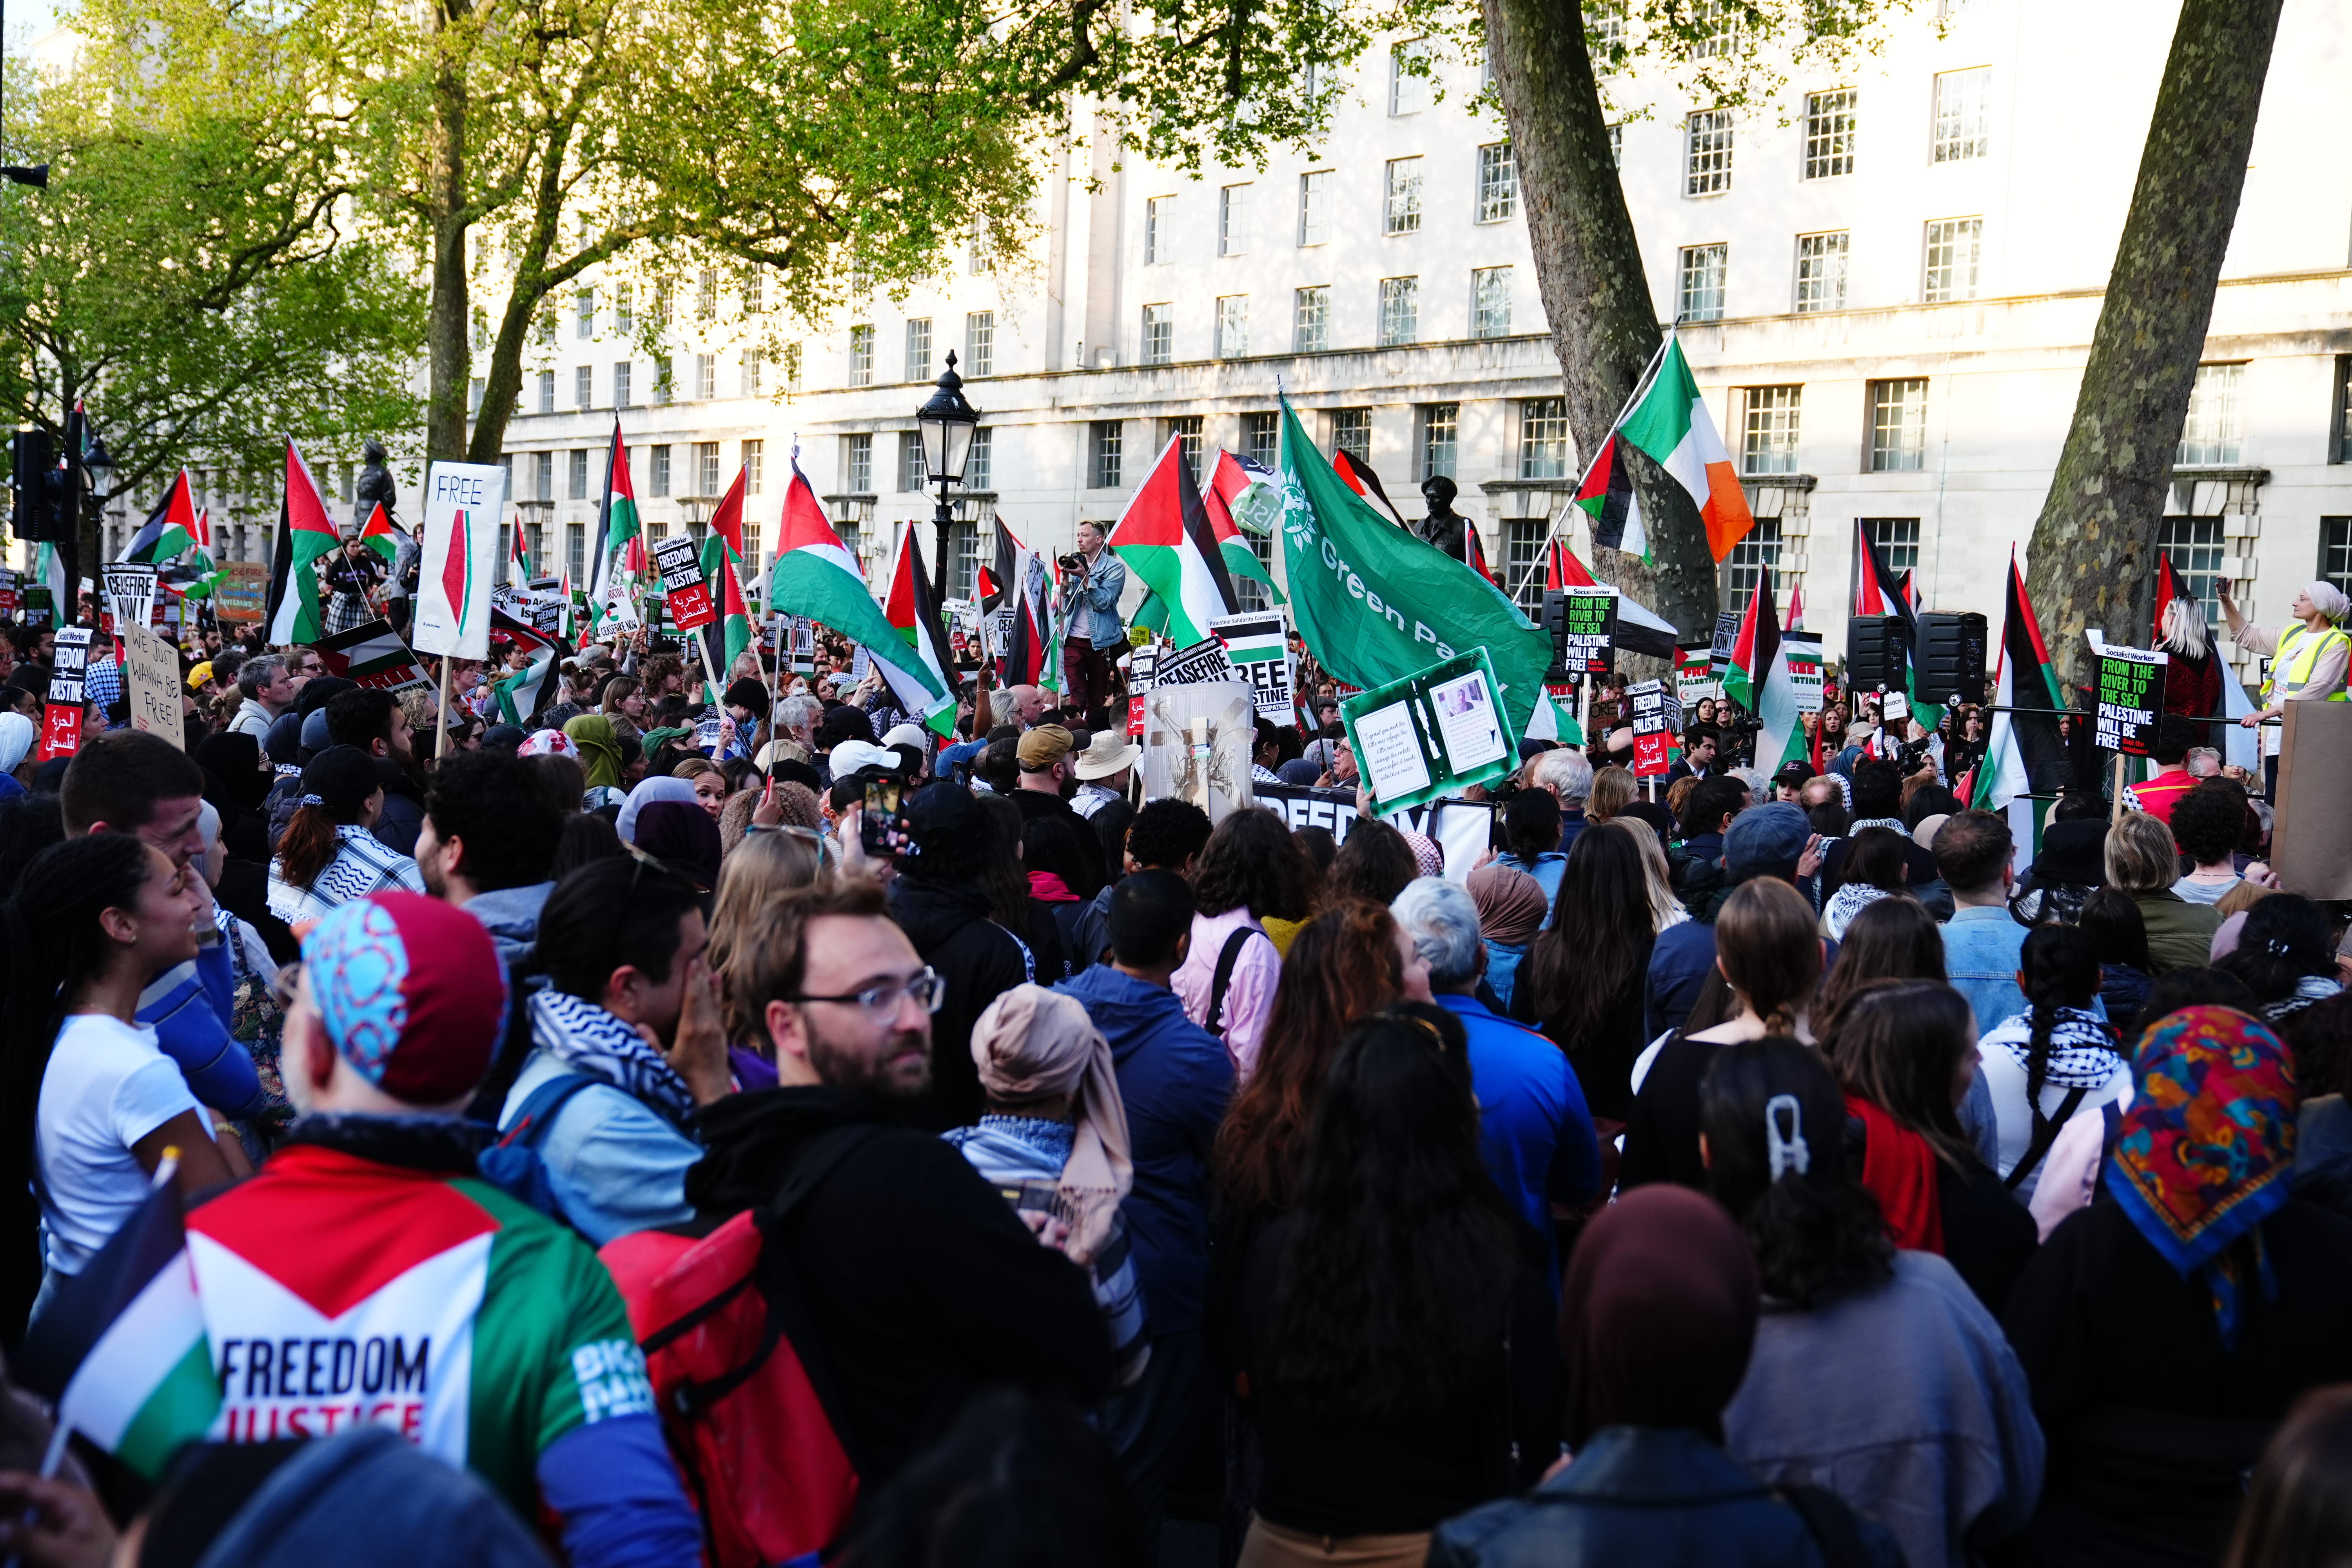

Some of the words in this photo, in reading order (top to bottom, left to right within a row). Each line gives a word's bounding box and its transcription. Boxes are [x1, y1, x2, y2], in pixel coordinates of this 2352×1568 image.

[437, 476, 483, 505] FREE
[657, 541, 673, 551] Socialist
[672, 537, 687, 546] Worker
[658, 546, 694, 570] FREEDOM
[1030, 559, 1045, 579] STOP!
[663, 566, 702, 591] PALESTINE
[1321, 536, 1404, 631] Green
[608, 588, 625, 601] NOCIDE
[674, 590, 701, 607] الحرية
[1595, 598, 1610, 609] THE
[677, 602, 708, 624] لفلسطين
[1569, 610, 1592, 622] RIVER
[1595, 610, 1605, 622] TO
[69, 632, 85, 641] Worker
[601, 621, 625, 636] CEASEFIRE
[627, 619, 637, 630] NOW
[1568, 622, 1586, 634] THE
[1587, 622, 1600, 634] SEA
[131, 626, 148, 653] WE
[152, 640, 173, 665] JUST
[1713, 632, 1732, 652] NOW!
[1159, 655, 1179, 671] PALESTINE
[1178, 647, 1198, 660] SOLIDARITY
[1197, 639, 1217, 653] CAMPAIGN
[1567, 646, 1586, 659] WILL
[1588, 647, 1598, 659] BE
[2106, 648, 2130, 659] Socialist
[2131, 653, 2155, 661] Worker
[354, 663, 417, 690] FREE
[1158, 649, 1230, 686] CEASEFIRE
[1235, 660, 1288, 690] REE
[1788, 661, 1816, 675] REE
[2102, 658, 2129, 676] FROM
[2133, 664, 2155, 679] THE
[132, 659, 162, 691] WANNA
[166, 676, 178, 698] BE
[1633, 683, 1648, 692] Socialist
[1791, 676, 1822, 685] STINE
[2101, 673, 2129, 691] RIVER
[2132, 679, 2147, 694] TO
[1253, 688, 1289, 704] STINE
[1633, 693, 1661, 711] FREEDOM
[1884, 699, 1902, 707] assacre
[2100, 688, 2118, 704] THE
[2120, 692, 2139, 708] SEA
[145, 691, 178, 737] FREE!
[1590, 701, 1617, 718] ORE
[2098, 702, 2153, 725] PALESTINE
[52, 710, 74, 731] الحرية
[1633, 715, 1664, 734] PALESTINE
[2097, 717, 2120, 735] WILL
[2123, 723, 2136, 738] BE
[1369, 730, 1381, 739] grant
[2095, 732, 2120, 750] FREE
[2123, 738, 2134, 746] Back
[1639, 737, 1659, 753] الحرية
[2122, 746, 2148, 754] resistance
[1375, 756, 1390, 764] change
[1398, 747, 1410, 755] rockets
[1638, 751, 1662, 769] لفلسطين
[1388, 760, 1399, 771] before
[222, 1337, 430, 1398] FREEDOM
[225, 1401, 423, 1444] JUSTIE
